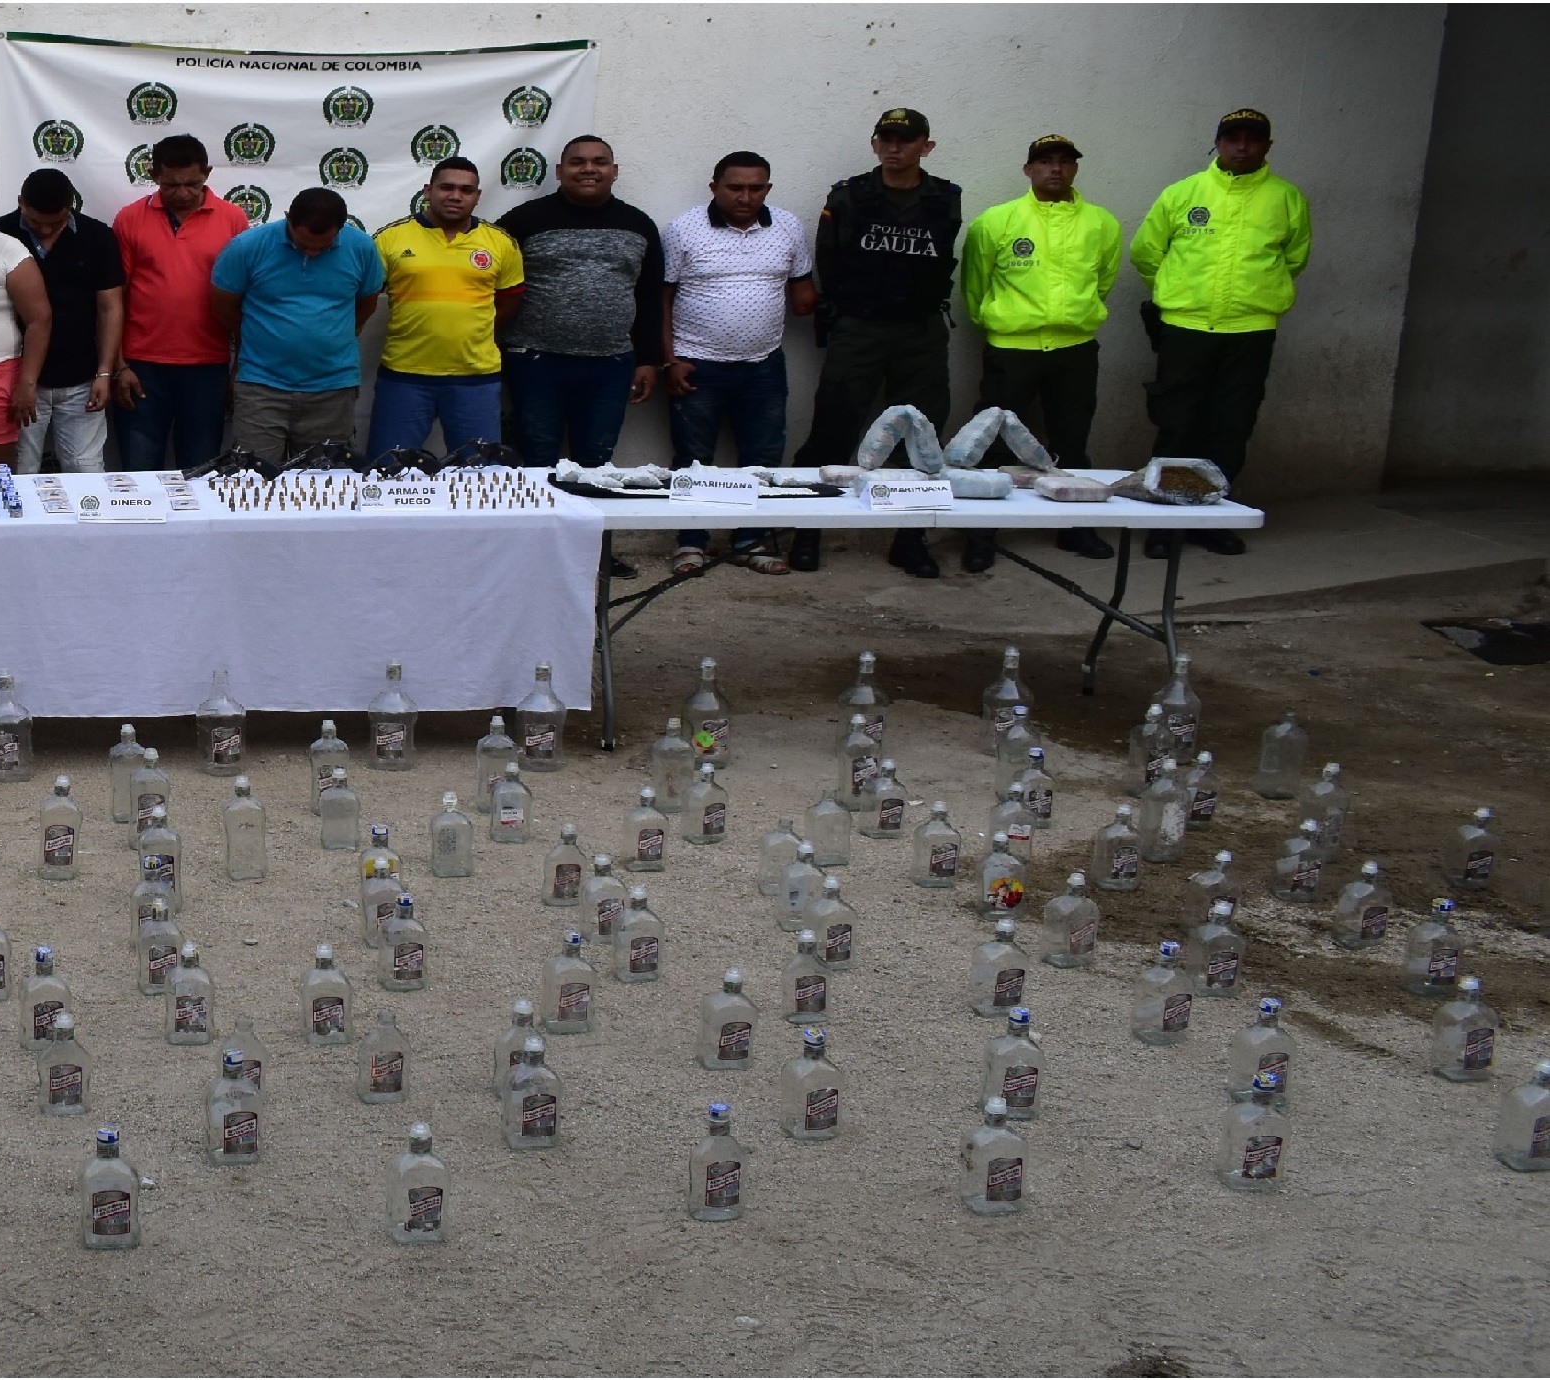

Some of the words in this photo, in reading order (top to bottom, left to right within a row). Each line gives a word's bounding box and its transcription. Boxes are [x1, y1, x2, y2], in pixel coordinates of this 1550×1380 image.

[176, 57, 235, 69] POLICÍA
[239, 59, 317, 71] NACIONAL
[321, 60, 340, 71] DE
[344, 60, 423, 71] COLOMBIA
[870, 223, 933, 239] POLICIA
[860, 233, 939, 257] GAULA
[692, 480, 753, 489] MARIHUANA
[387, 487, 419, 496] ARMA
[422, 487, 436, 495] DE
[394, 497, 431, 505] FUEGO
